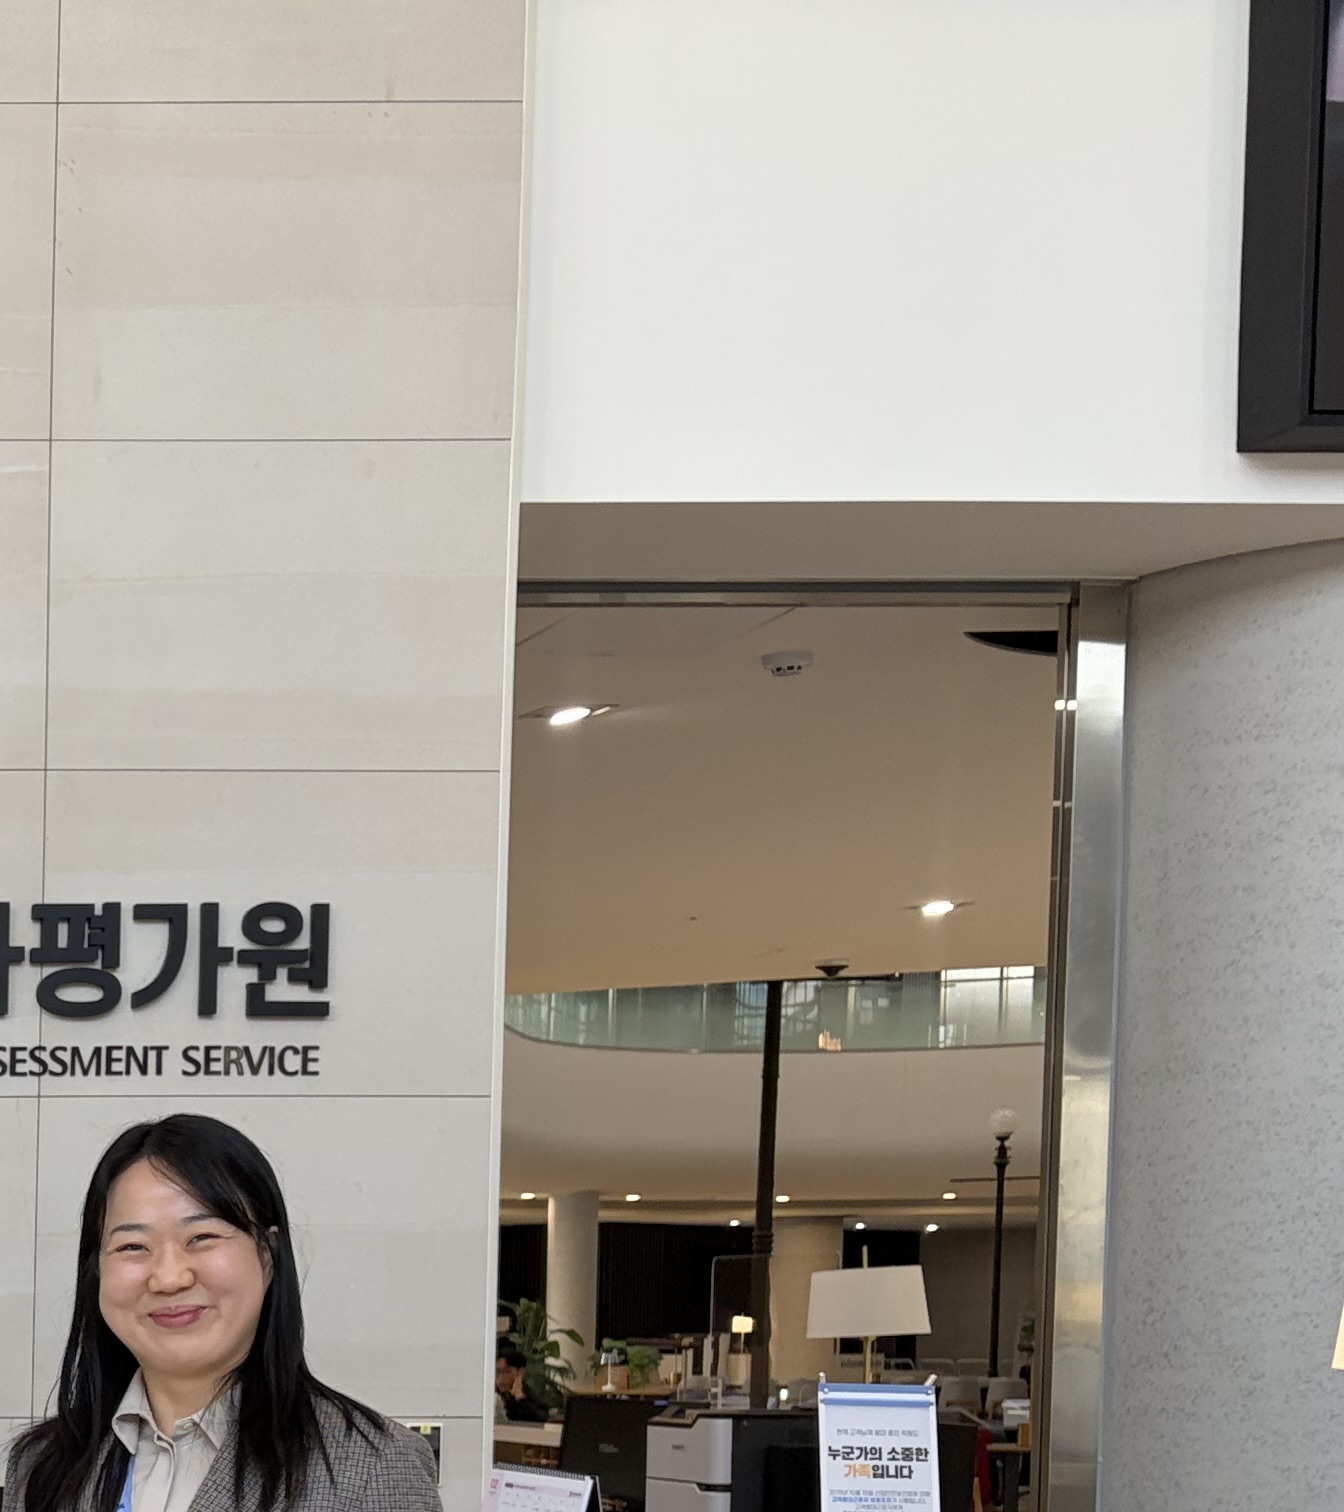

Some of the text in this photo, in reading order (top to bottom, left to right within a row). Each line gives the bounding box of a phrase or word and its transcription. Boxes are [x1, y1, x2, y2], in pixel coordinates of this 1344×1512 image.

[181, 1044, 321, 1077] SERVICE
[827, 1445, 930, 1462] 누군가의 소중한
[844, 1463, 914, 1480] 가족입니다
